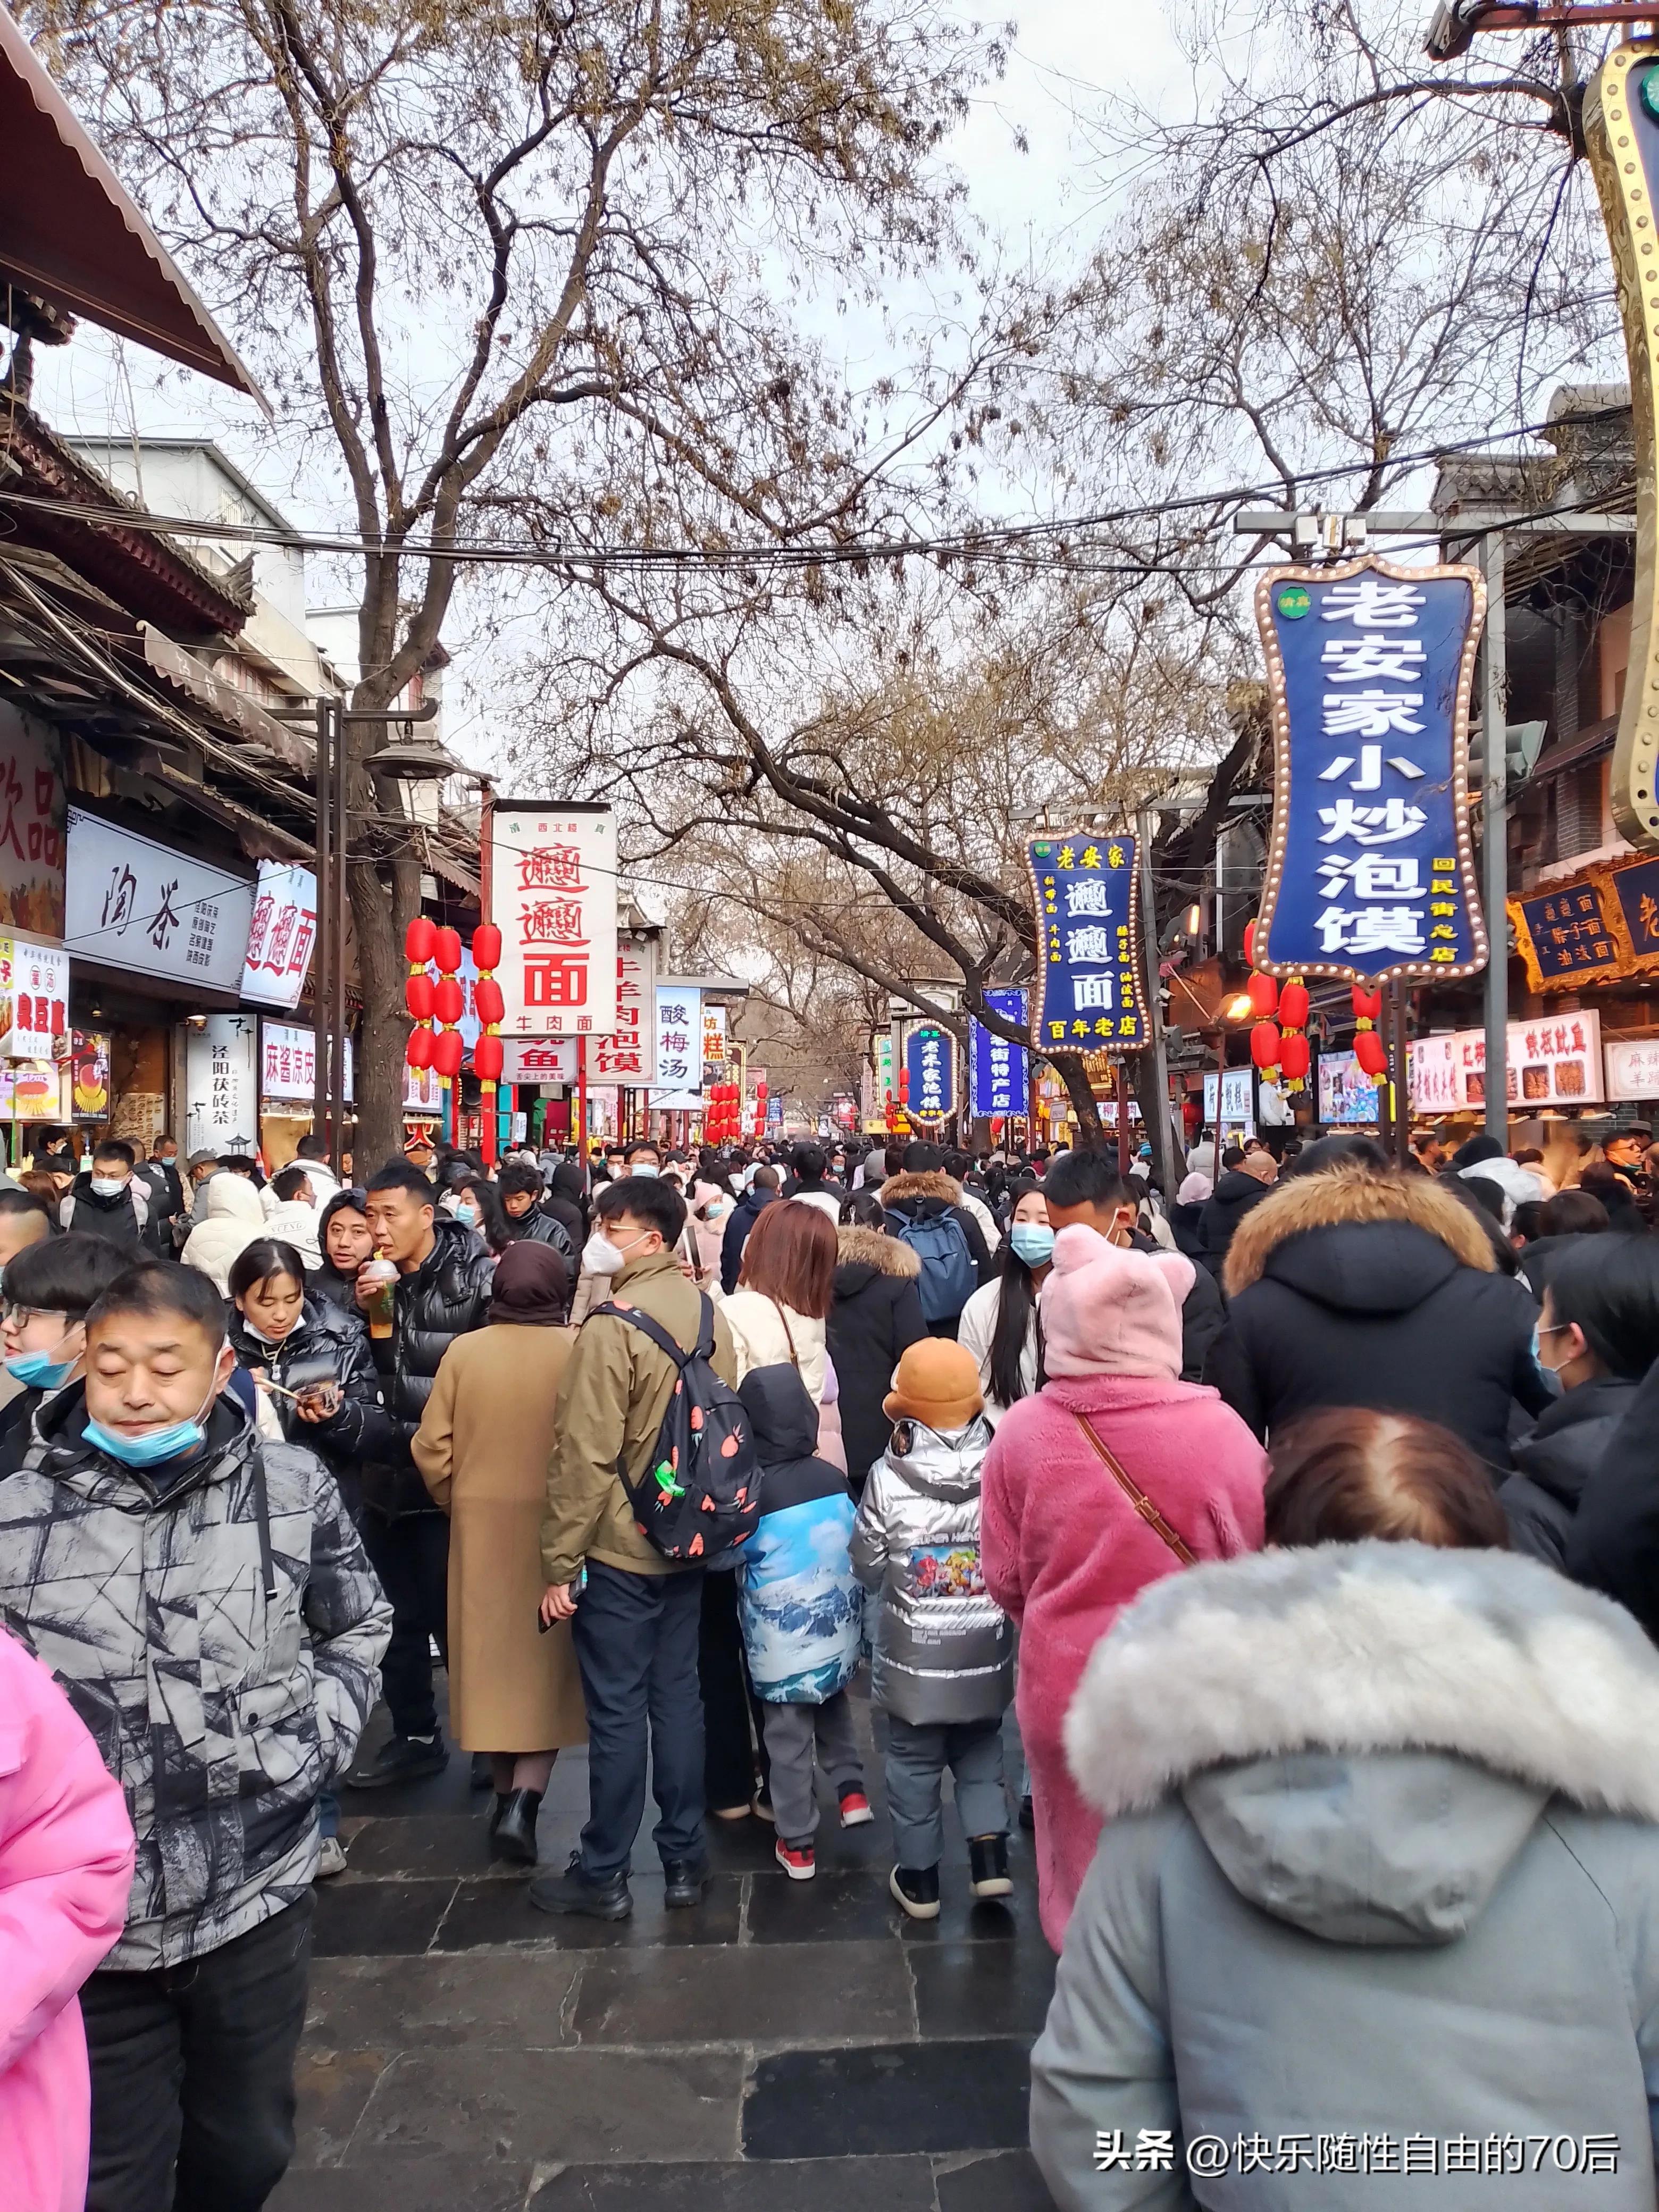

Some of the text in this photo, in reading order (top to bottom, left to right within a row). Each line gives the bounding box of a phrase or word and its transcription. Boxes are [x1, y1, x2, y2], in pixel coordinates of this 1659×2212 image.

[1314, 581, 1428, 956] 老安家小炒泡馍
[538, 823, 577, 832] 西北楼
[1057, 845, 1125, 869] 老安家
[1429, 857, 1459, 962] 回民街总店
[1049, 924, 1062, 962] 牛肉面
[516, 1015, 593, 1031] 牛肉面
[659, 1003, 690, 1079] 酸梅汤
[1048, 1015, 1137, 1040] 百年老店
[266, 1041, 315, 1085] 麻酱凉皮
[212, 1045, 230, 1125] 泾阳茯砖茶
